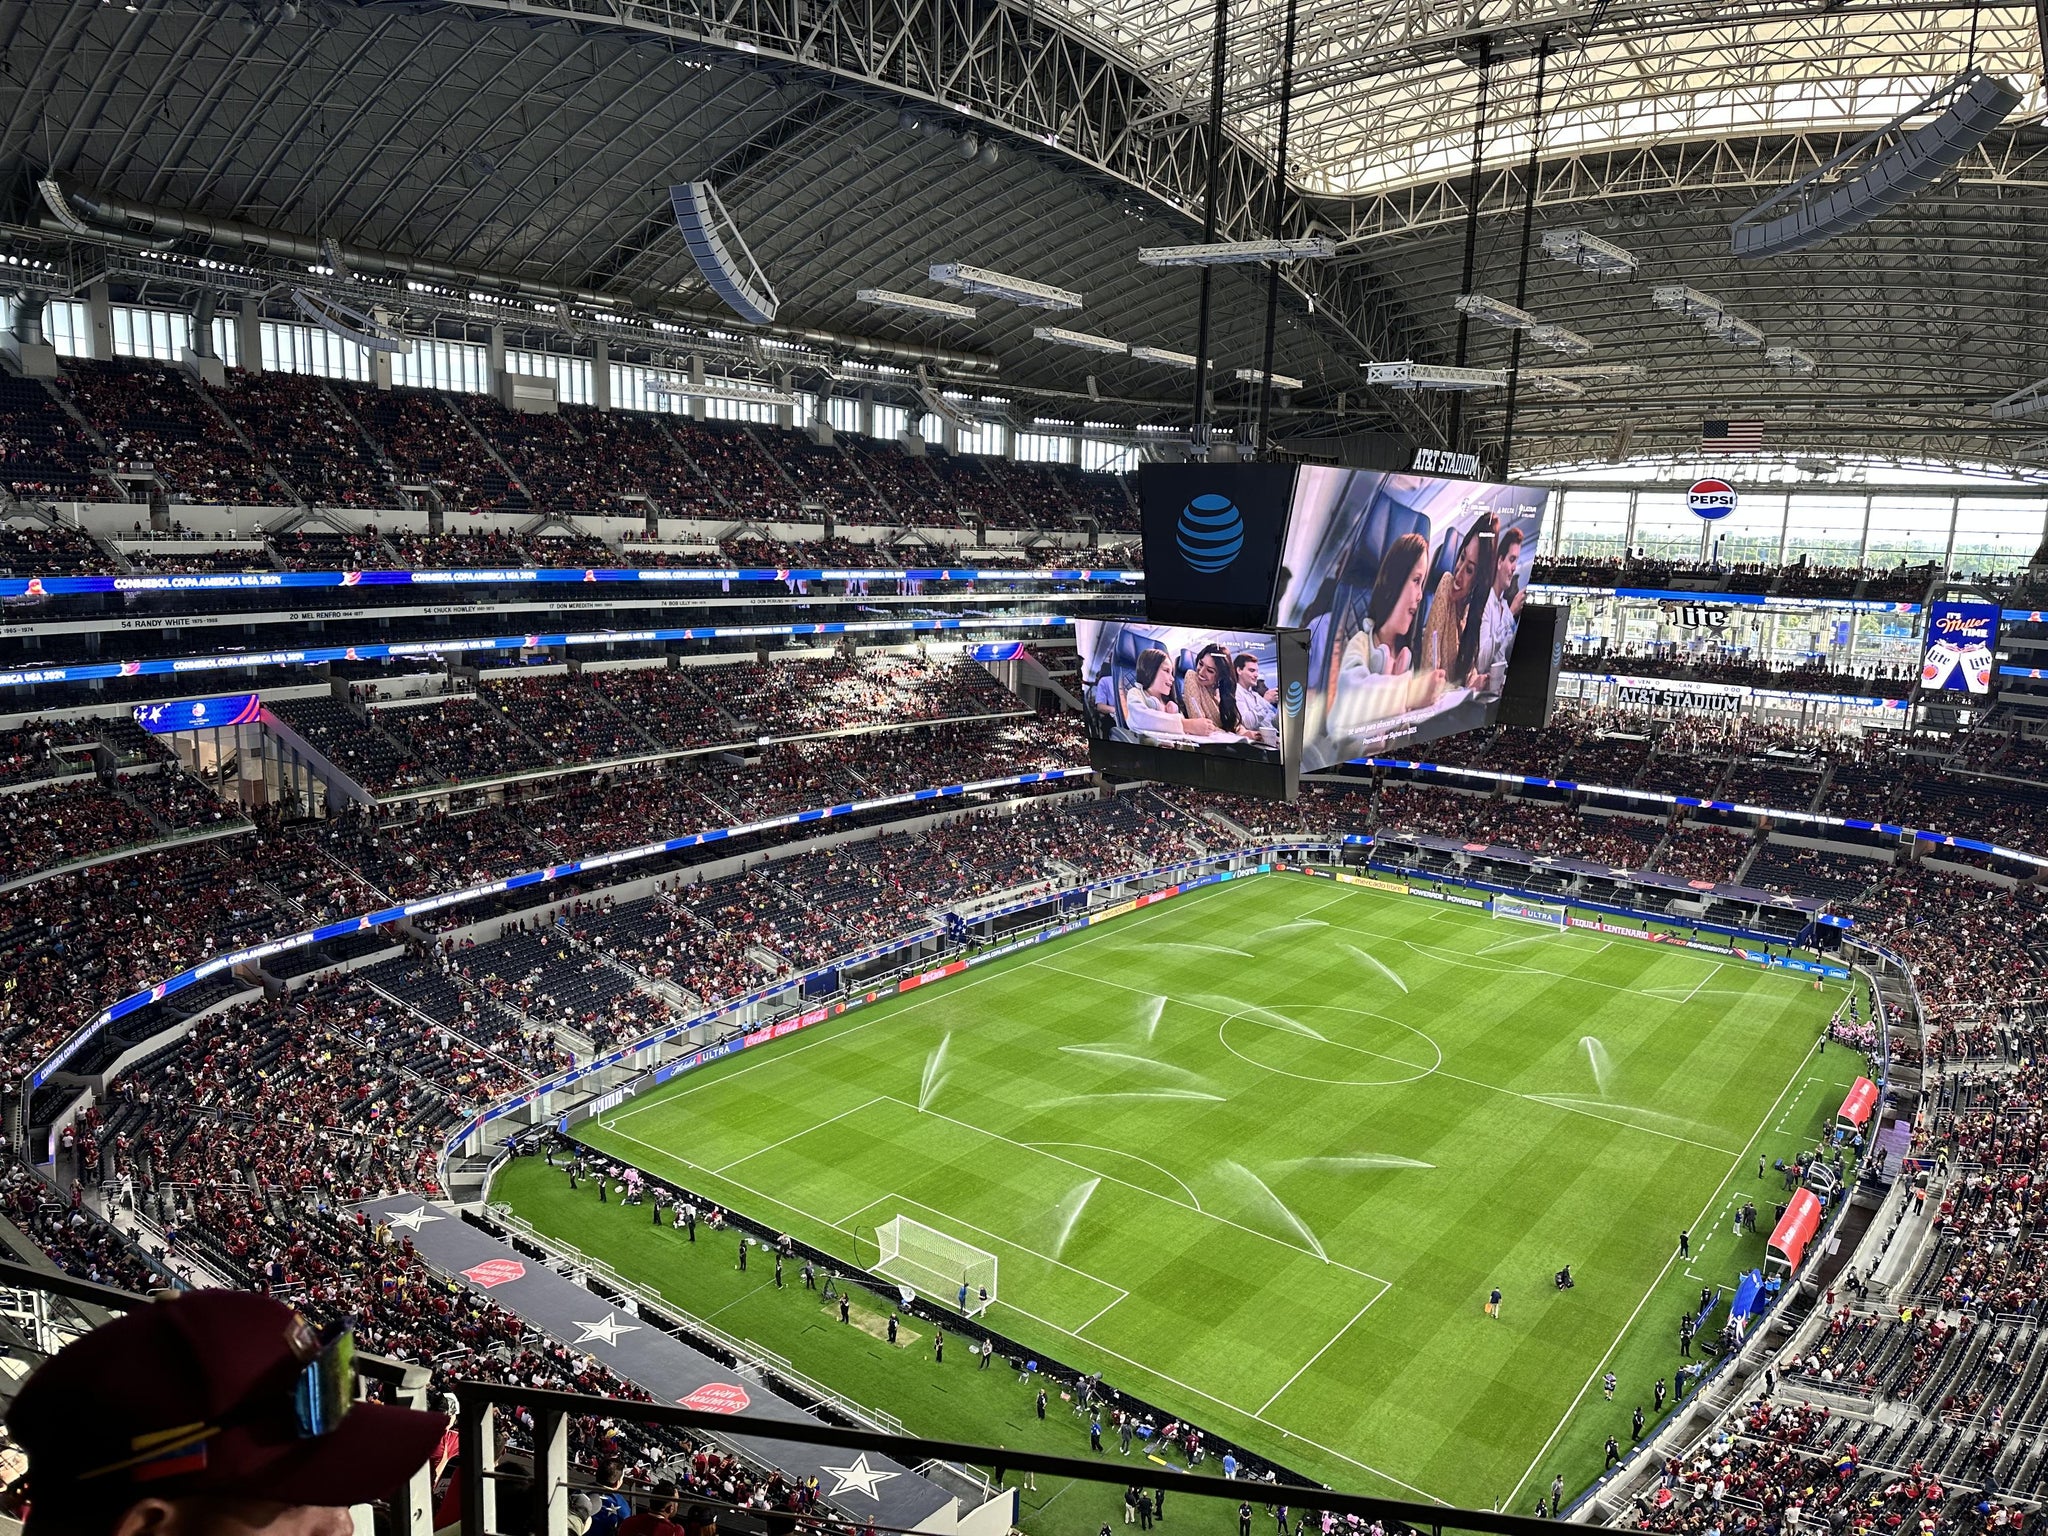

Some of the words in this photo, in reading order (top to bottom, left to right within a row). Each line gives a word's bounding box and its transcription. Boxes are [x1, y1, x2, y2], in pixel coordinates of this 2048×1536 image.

[1413, 448, 1440, 472] AT&T
[1438, 451, 1480, 476] STADIUM
[1690, 496, 1733, 505] PEPSI
[114, 578, 172, 589] CONMEBOL
[172, 578, 198, 587] COPA
[197, 576, 240, 587] AMERICA
[241, 576, 259, 586] USA
[260, 575, 281, 585] 2024
[135, 620, 162, 628] RANDY
[165, 618, 190, 626] WHITE
[1674, 605, 1724, 630] Lite
[1936, 618, 1990, 634] Miller
[1962, 628, 1988, 638] TIME
[173, 660, 217, 670] CONMEBOL
[218, 657, 239, 666] COPA
[271, 655, 286, 663] USA
[24, 673, 43, 683] USA
[44, 671, 66, 682] 2024
[1618, 687, 1660, 704] AT&T
[1663, 690, 1739, 711] STADIUM
[1238, 867, 1257, 879] Degree
[1355, 877, 1384, 888] mercado
[1386, 881, 1402, 892] libre
[1410, 888, 1443, 900] POWERADE
[1447, 895, 1483, 908] POWERADE
[1528, 910, 1552, 921] ULTRA
[1066, 921, 1082, 931] ULTRA
[1571, 918, 1600, 930] TEQUILA
[1602, 924, 1648, 939] CENTENARIO
[1666, 938, 1687, 946] INTER
[802, 1010, 825, 1027] Coca-Cola
[775, 1020, 799, 1037] Coca-Cola
[746, 1031, 770, 1048] Coca-Cola
[702, 1045, 730, 1061] ULTRA
[589, 1089, 623, 1116] PUMA
[701, 1389, 741, 1398] ARMY
[686, 1395, 746, 1408] SALVATION
